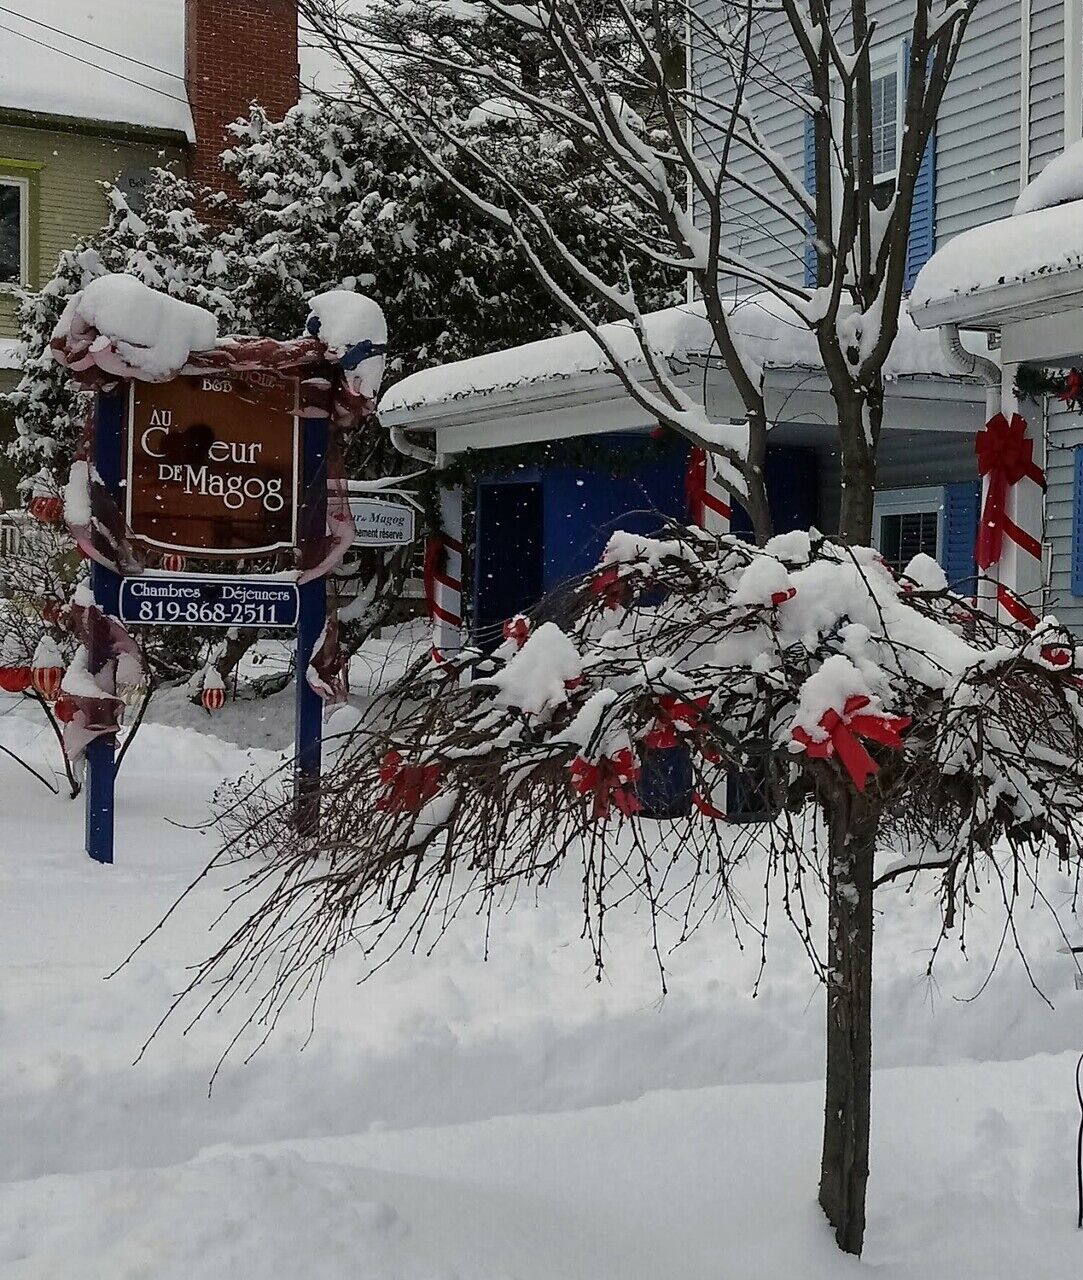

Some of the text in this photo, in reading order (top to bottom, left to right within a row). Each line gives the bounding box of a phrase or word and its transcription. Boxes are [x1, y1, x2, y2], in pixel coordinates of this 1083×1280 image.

[150, 409, 172, 427] AU
[158, 464, 284, 512] DE Magog
[369, 512, 405, 527] Magog
[130, 582, 290, 604] Chambres Déjeuners
[139, 600, 279, 624] 819-868-2511
